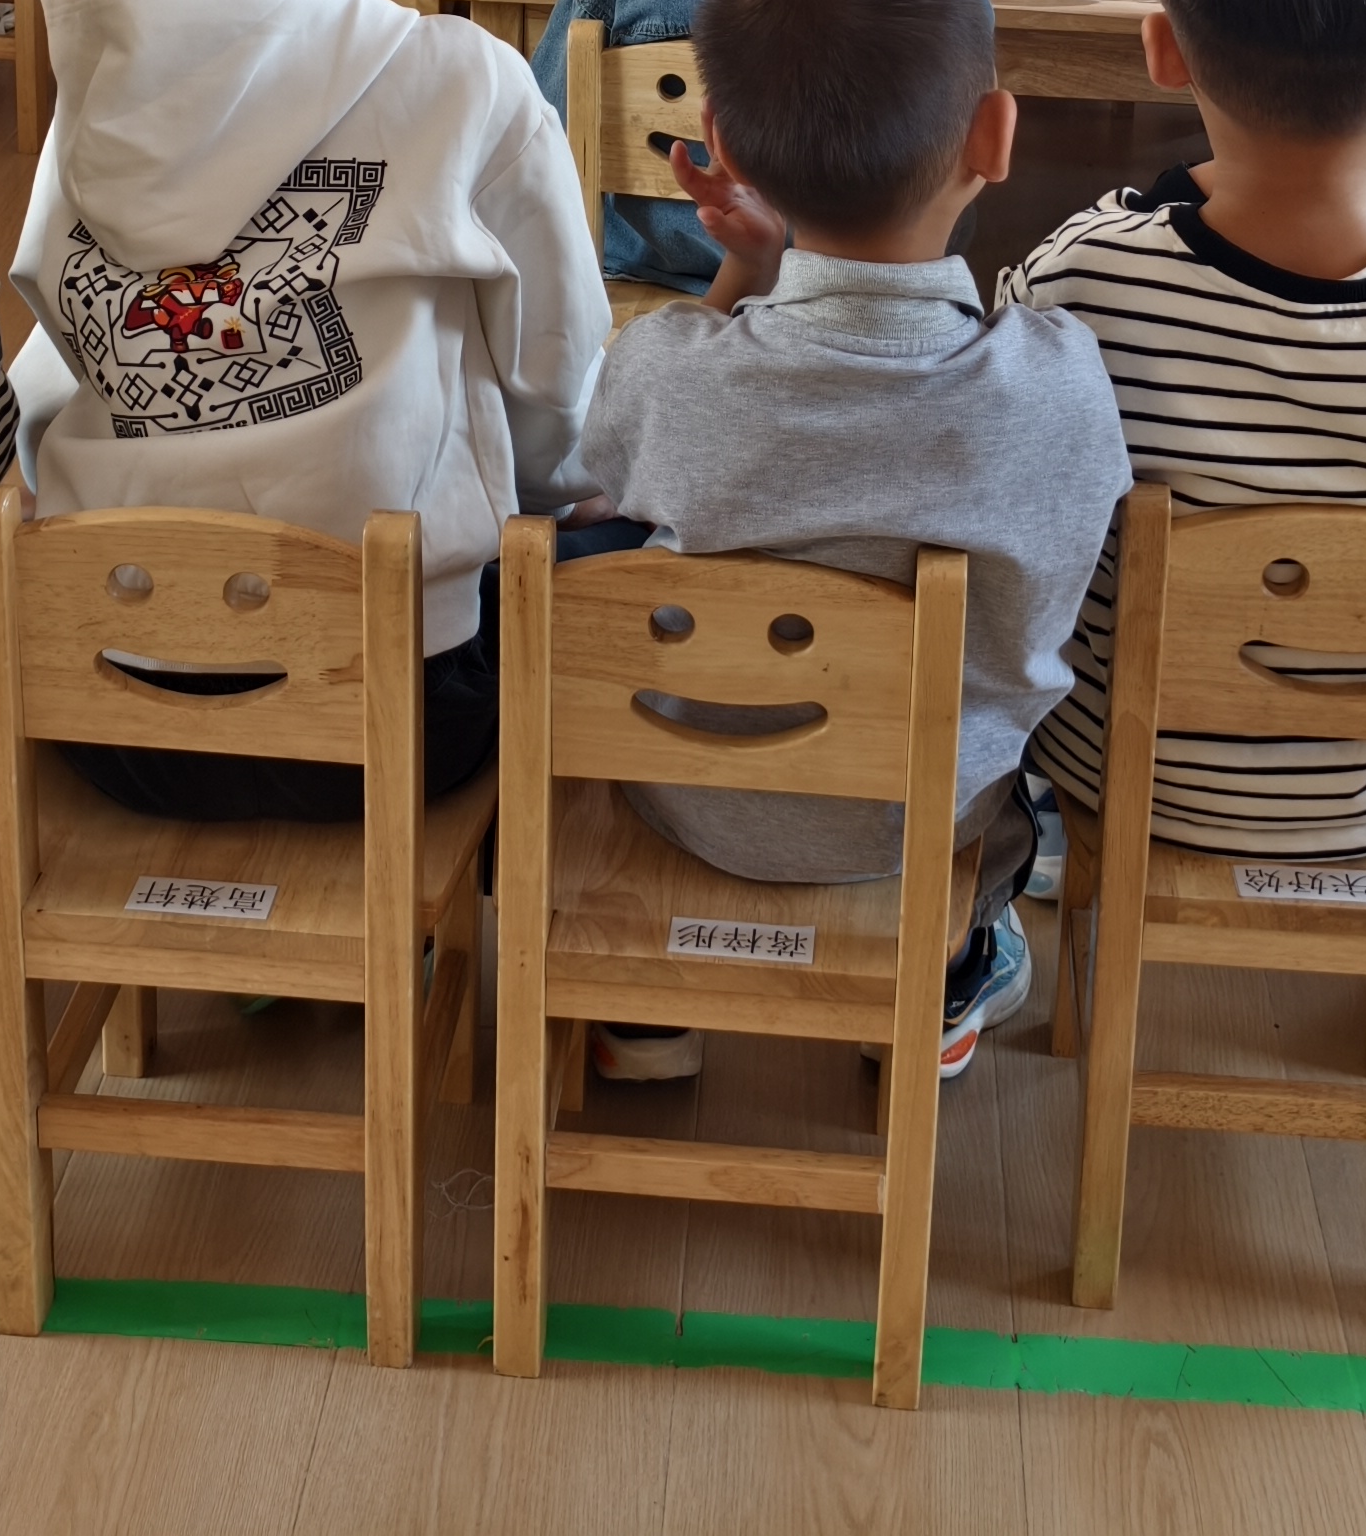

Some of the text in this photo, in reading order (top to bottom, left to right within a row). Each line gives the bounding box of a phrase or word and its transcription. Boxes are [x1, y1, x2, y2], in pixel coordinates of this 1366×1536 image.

[135, 880, 267, 914] 高楚轩
[677, 923, 808, 958] 蒋梓彤
